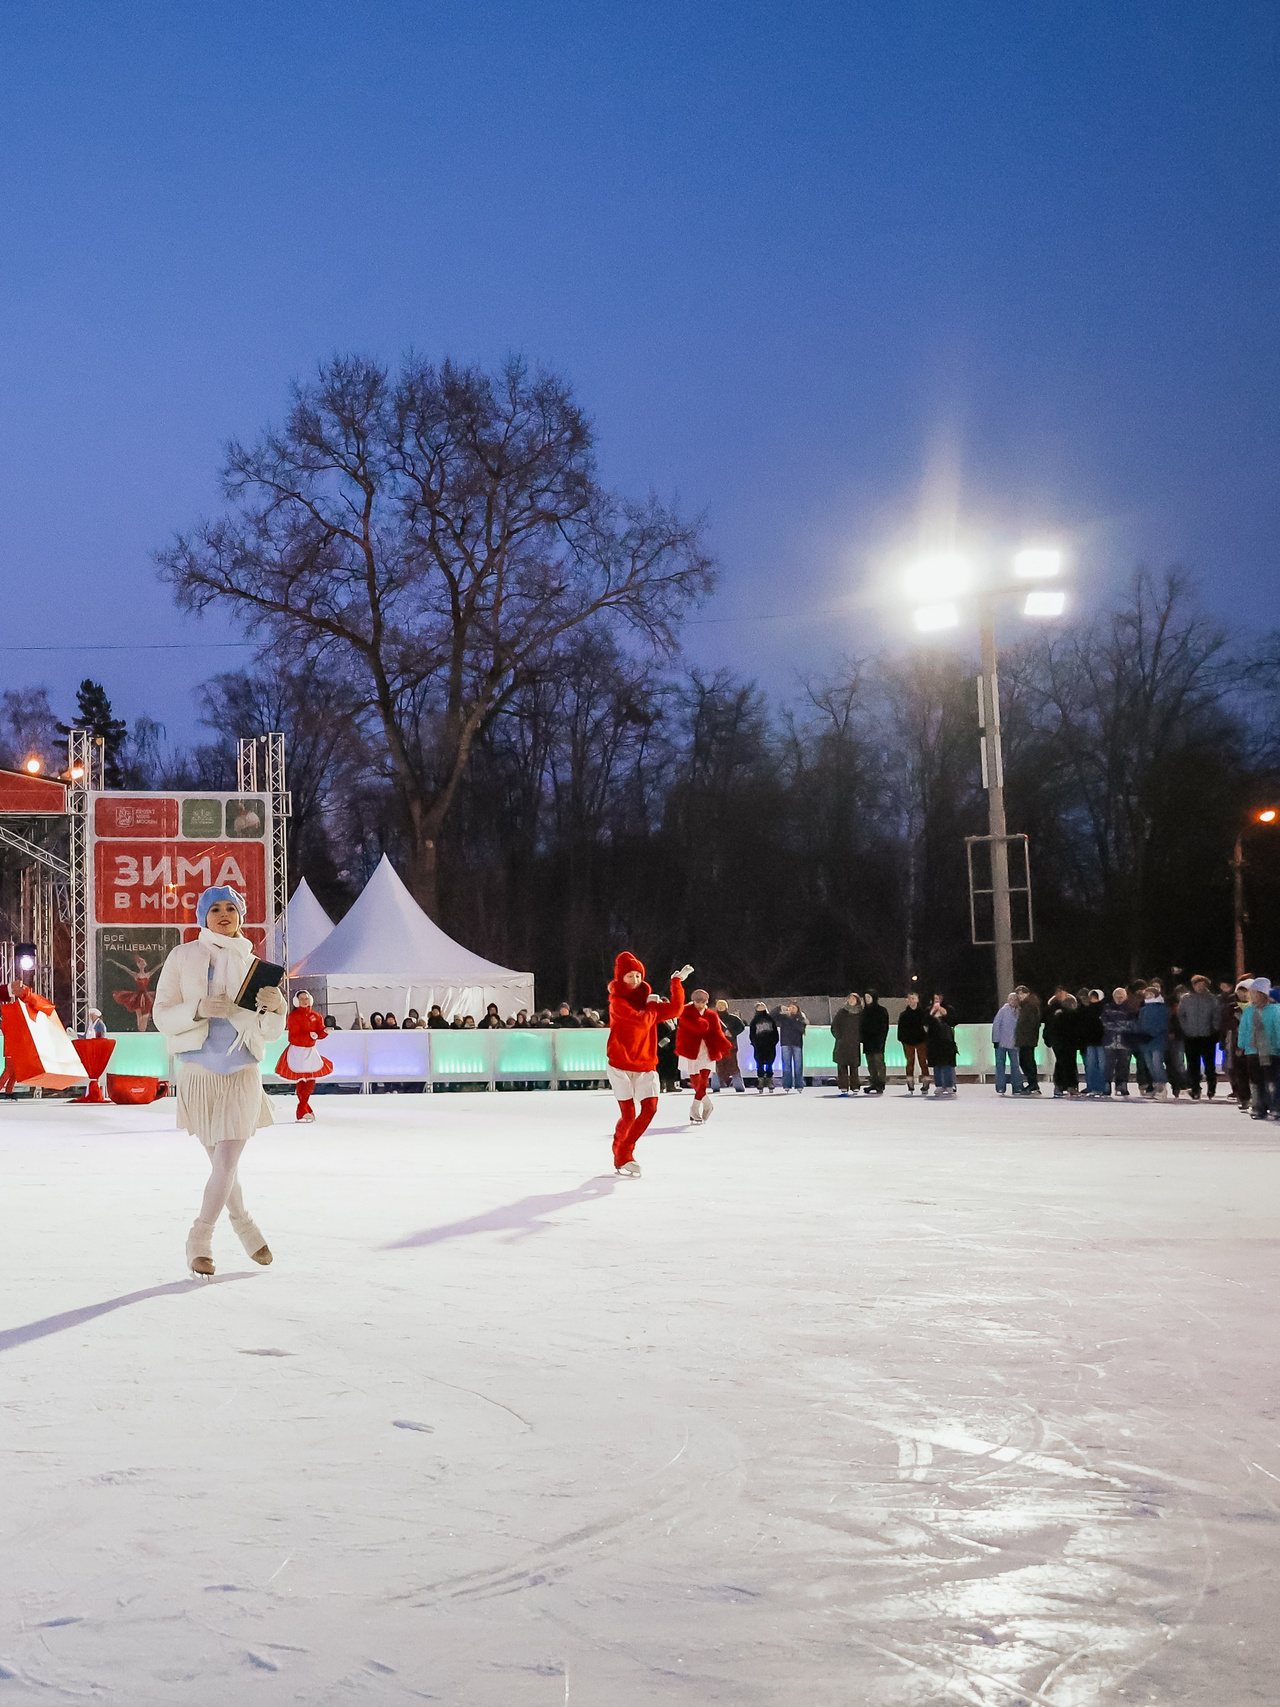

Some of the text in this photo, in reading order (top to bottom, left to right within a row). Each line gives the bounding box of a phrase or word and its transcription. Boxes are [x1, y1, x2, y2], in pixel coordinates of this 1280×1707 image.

[114, 855, 247, 887] ЗИМА
[114, 892, 131, 909] В
[103, 934, 125, 942] ВСЕ
[104, 943, 167, 952] ТАНЦЕВАТЬ!
